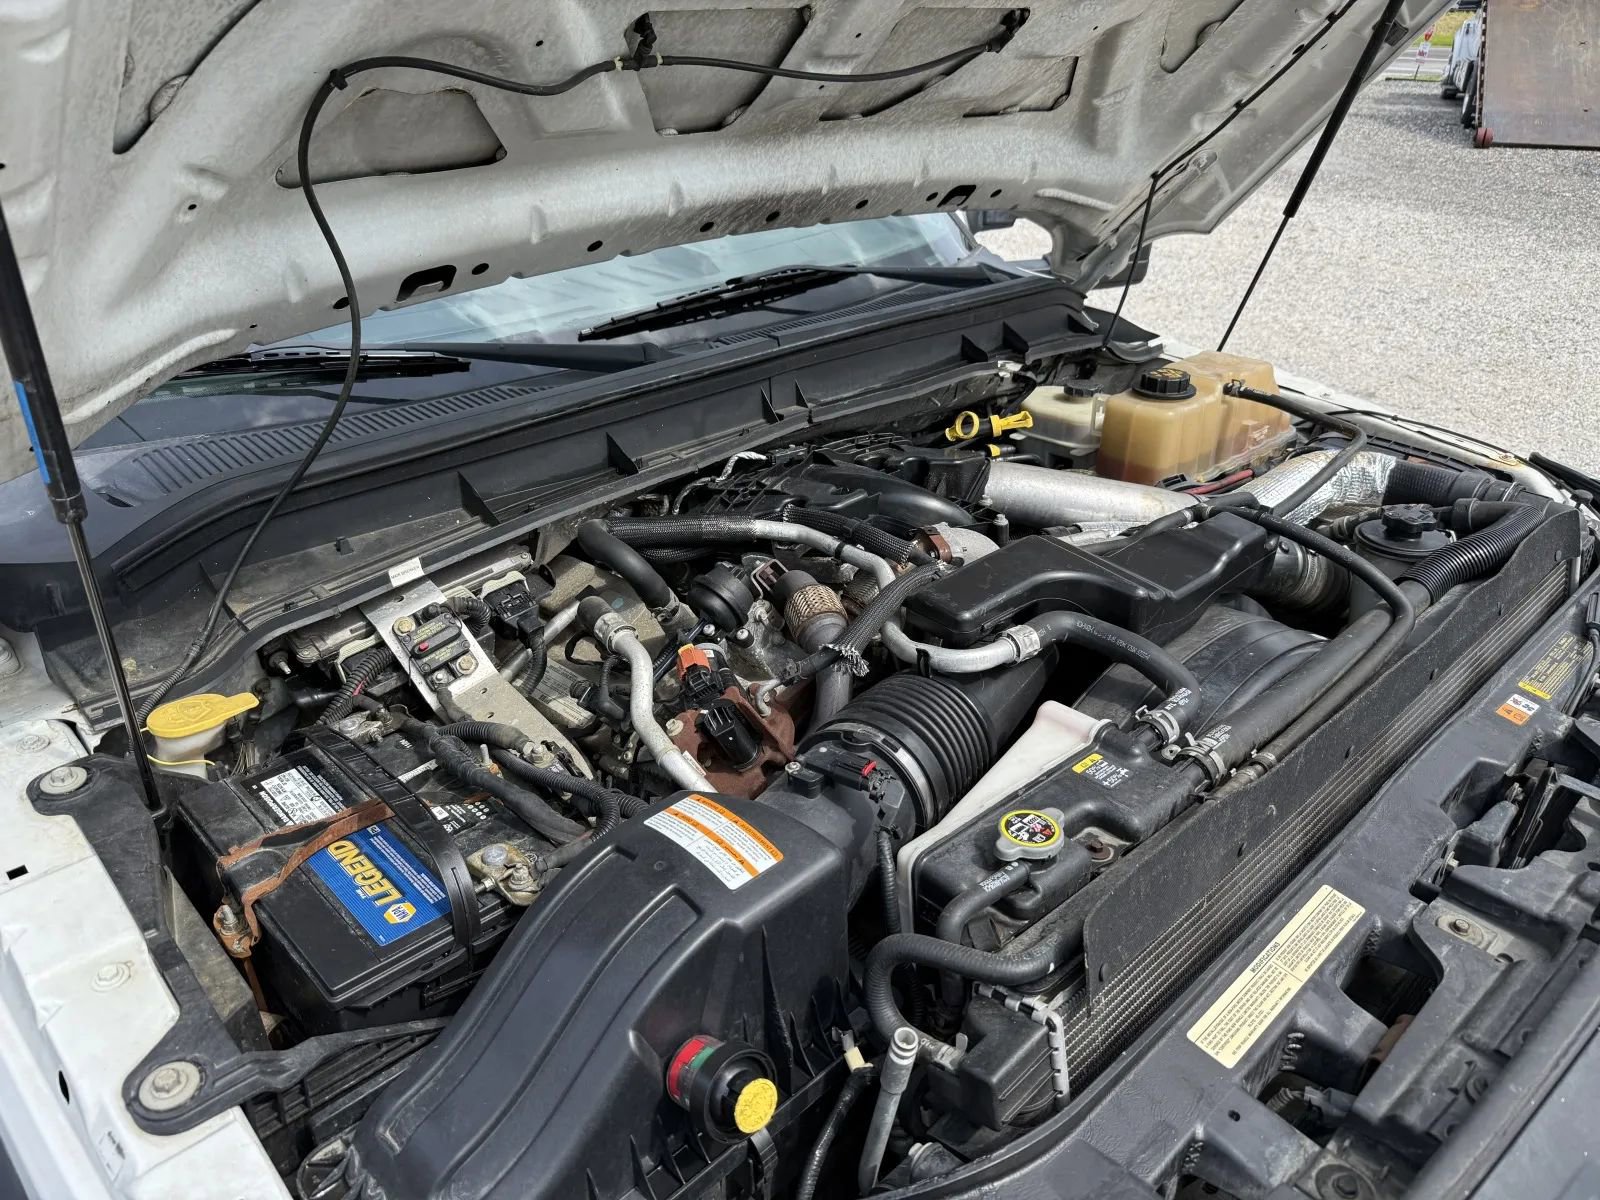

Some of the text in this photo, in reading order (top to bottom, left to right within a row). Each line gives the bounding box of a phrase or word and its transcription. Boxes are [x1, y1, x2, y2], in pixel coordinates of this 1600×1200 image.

[327, 840, 402, 906] LEGEND
[391, 905, 409, 921] NAPA
[1249, 941, 1281, 973] MODIFICATIONS
